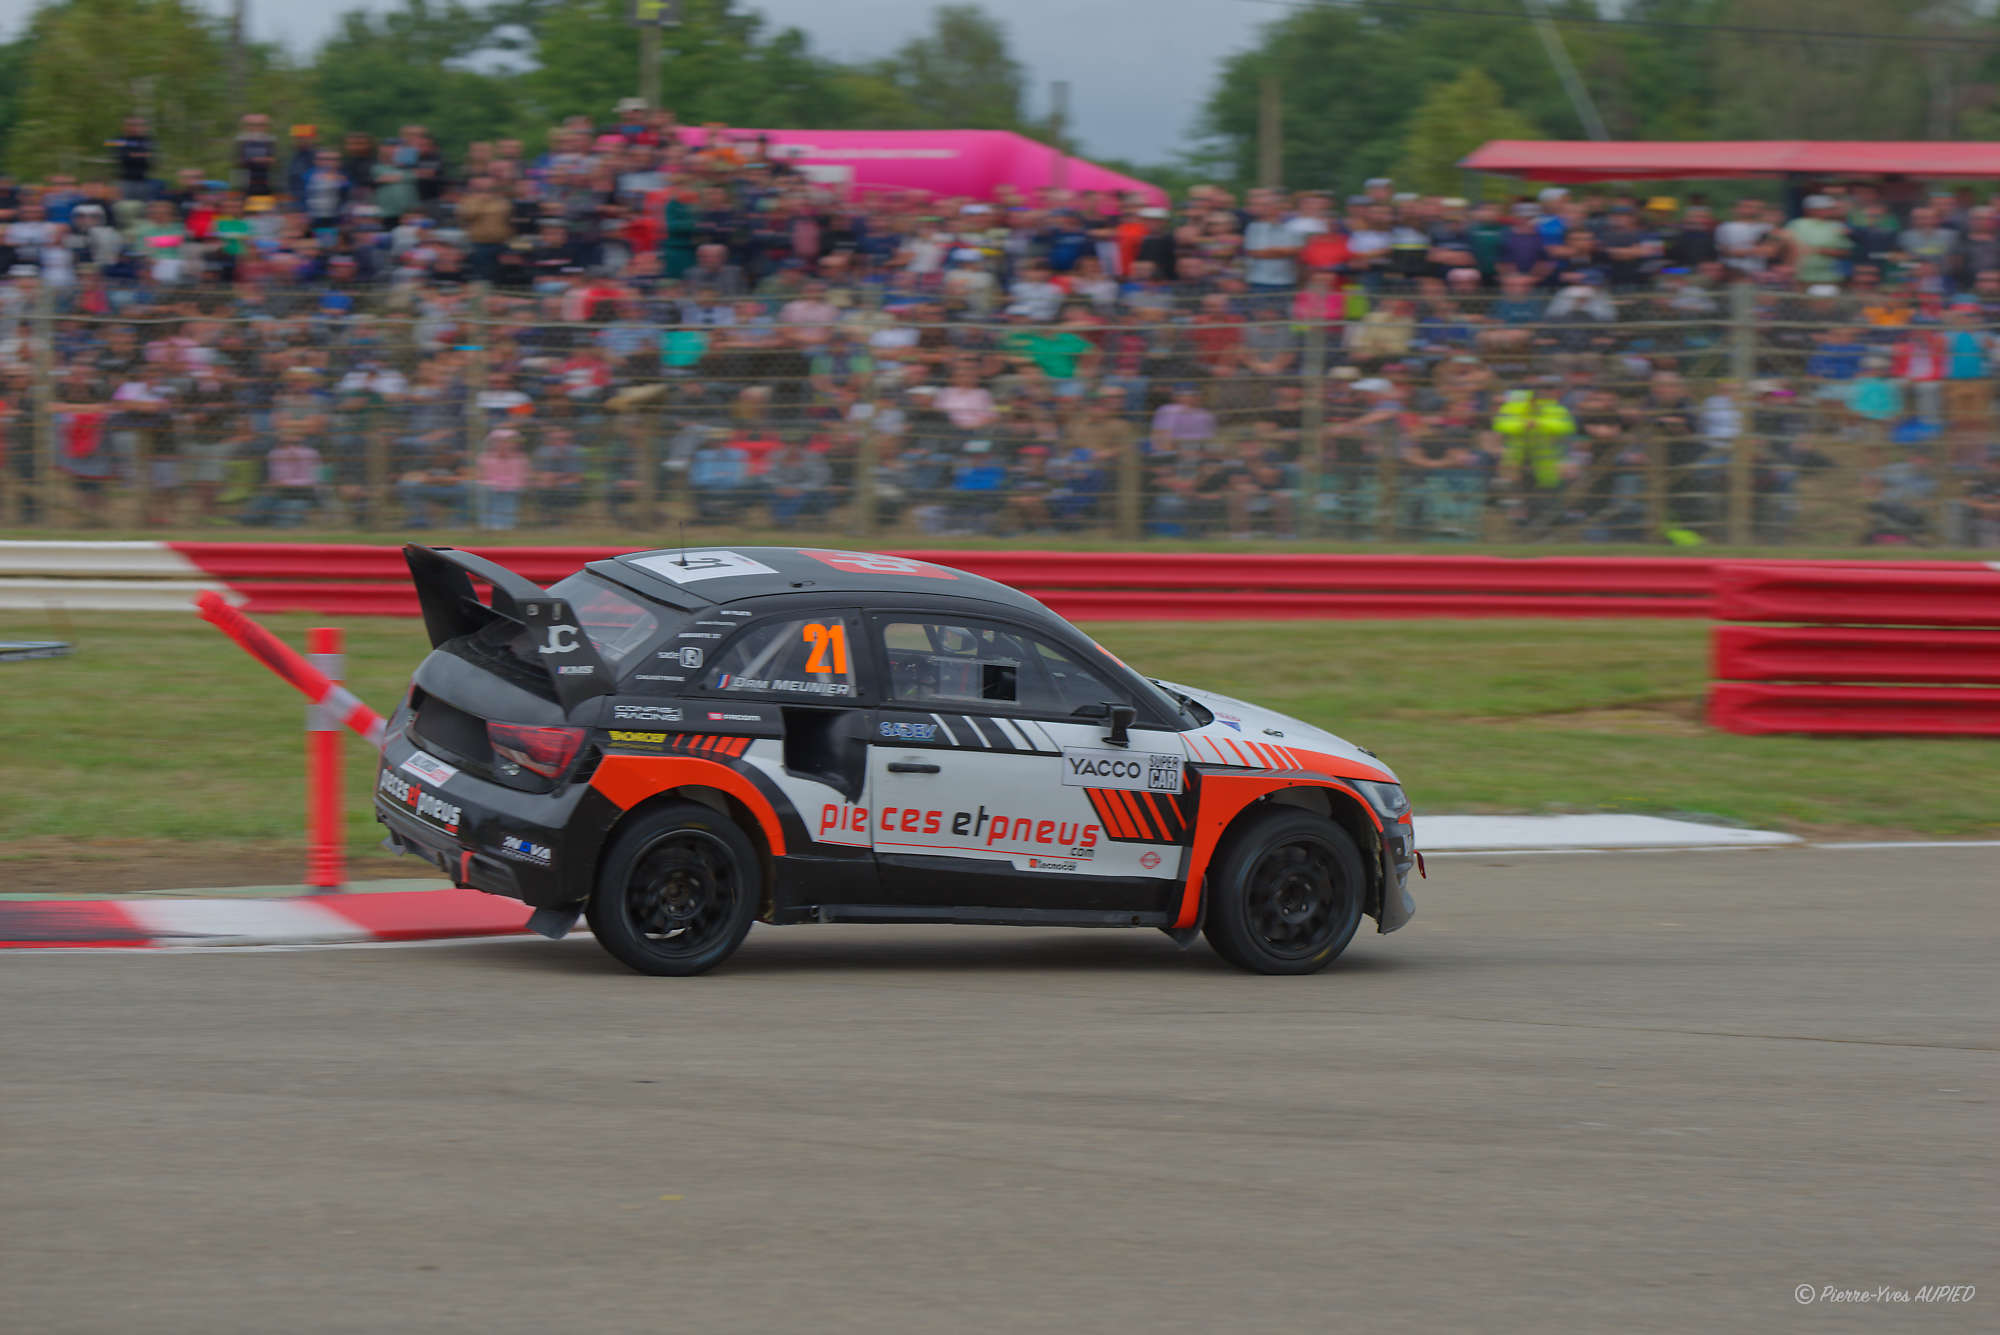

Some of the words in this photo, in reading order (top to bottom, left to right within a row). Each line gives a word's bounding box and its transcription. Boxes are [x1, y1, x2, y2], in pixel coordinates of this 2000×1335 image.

[803, 623, 848, 674] 21
[771, 680, 850, 695] MEUNIER
[614, 712, 682, 721] RACING
[1069, 758, 1141, 779] YACCO
[1149, 754, 1179, 768] SUPER
[1149, 769, 1177, 789] CAR
